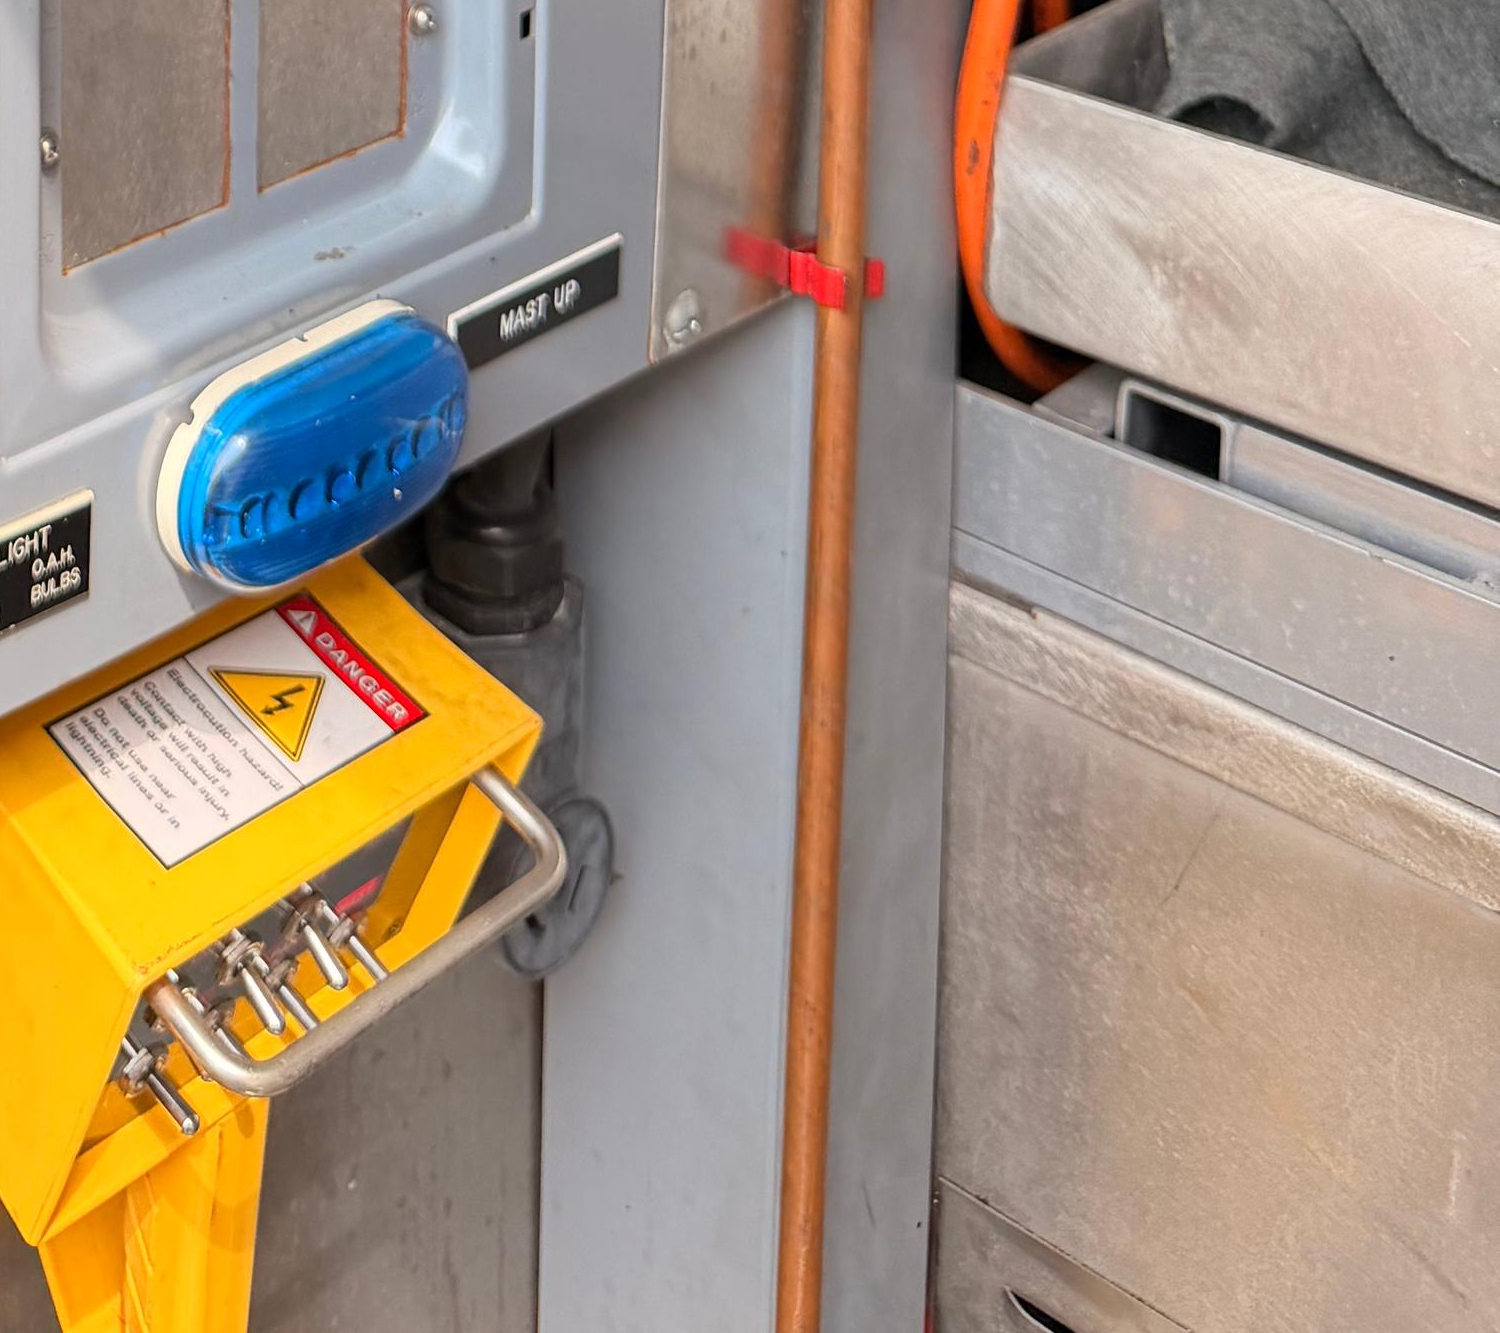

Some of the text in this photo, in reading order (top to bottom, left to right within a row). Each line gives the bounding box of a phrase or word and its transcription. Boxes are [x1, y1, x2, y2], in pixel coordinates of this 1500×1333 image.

[500, 279, 581, 341] MAST UP
[30, 566, 82, 609] BULBS
[315, 632, 409, 721] DANGER
[66, 722, 111, 779] lightning.
[80, 716, 180, 828] electrical lines or in
[93, 708, 177, 800] Do not use near
[117, 695, 230, 821] death or serious injury.
[129, 688, 230, 797] voltage will result in
[144, 681, 232, 778] Contact with high
[167, 668, 284, 792] Electrocution hazard!
